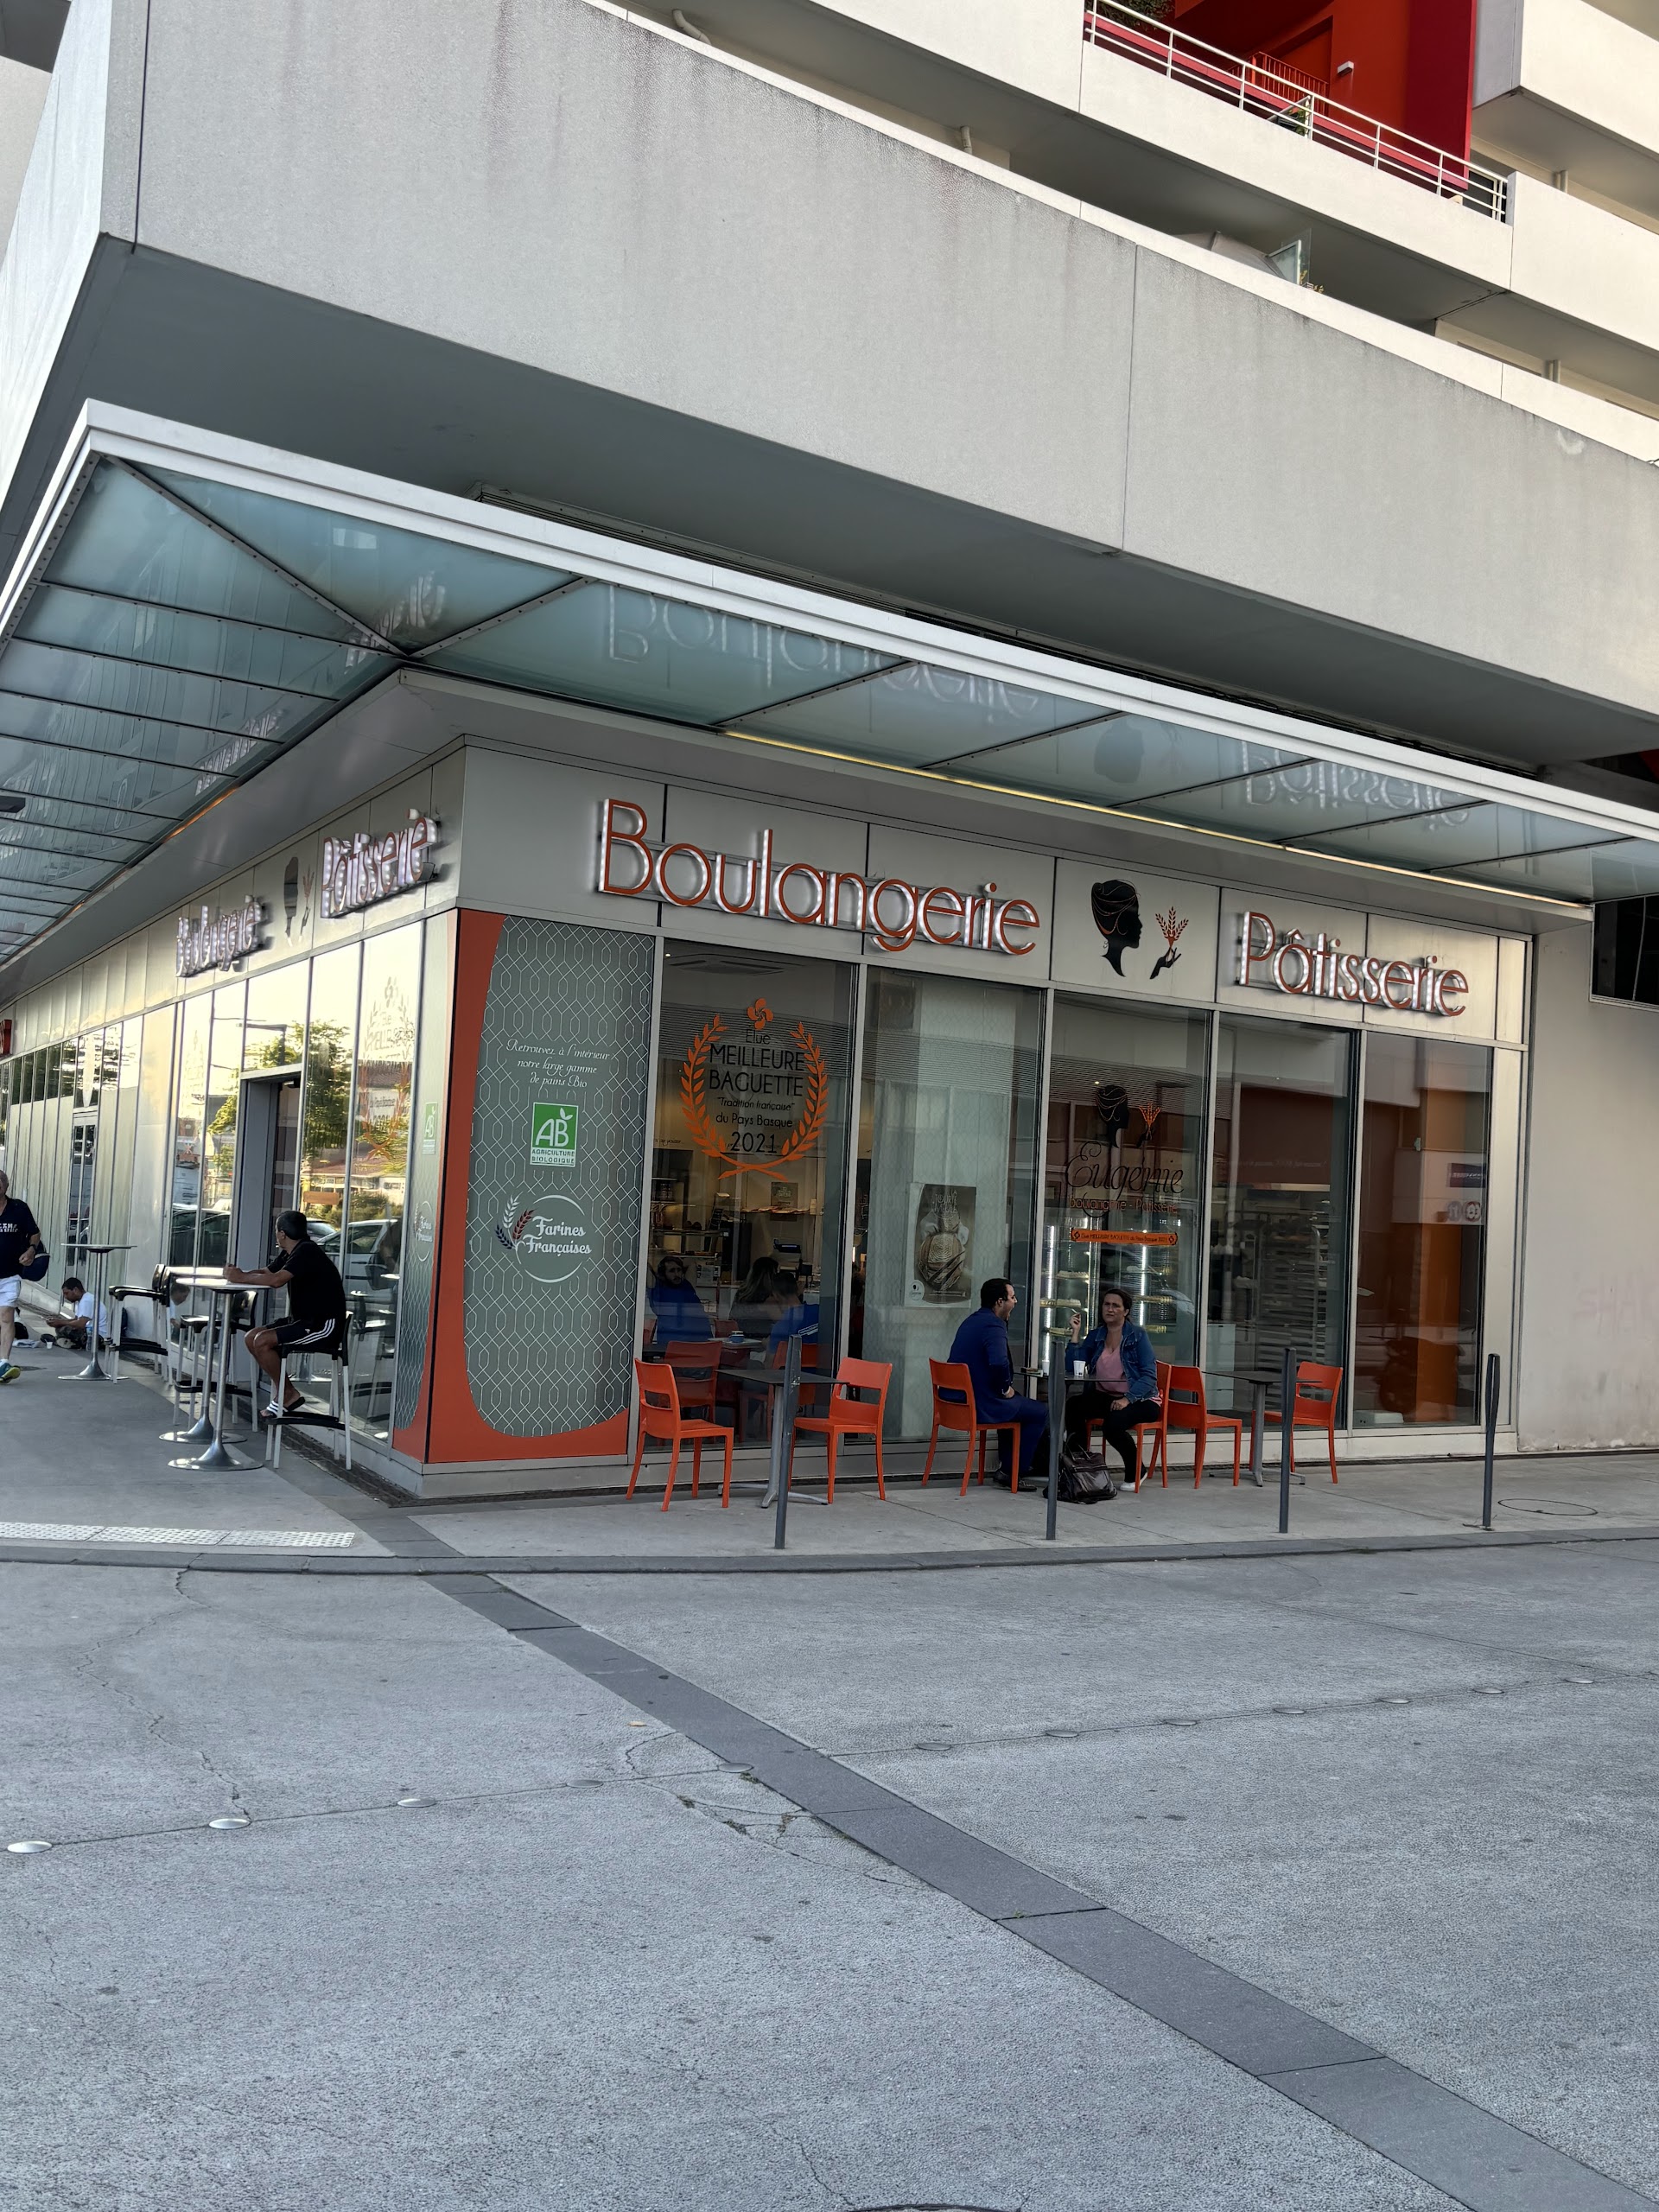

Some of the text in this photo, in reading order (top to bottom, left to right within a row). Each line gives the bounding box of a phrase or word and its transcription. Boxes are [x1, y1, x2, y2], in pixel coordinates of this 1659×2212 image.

[598, 798, 1040, 956] Boulangerie
[1239, 911, 1469, 1016] Pâtisserie
[506, 1039, 556, 1055] Retrouvez
[558, 1047, 565, 1056] à
[709, 1043, 804, 1071] MEILLEURE
[518, 1056, 598, 1077] notre large gamme
[530, 1071, 588, 1093] de pains Bio
[709, 1069, 804, 1096] BAGUETTE
[715, 1112, 793, 1129] du Pays Basque
[535, 1118, 569, 1147] AB
[730, 1131, 778, 1154] 2021
[531, 1148, 575, 1157] AGRICULTURE
[532, 1215, 587, 1236] Farines
[523, 1234, 592, 1256] Françaises
